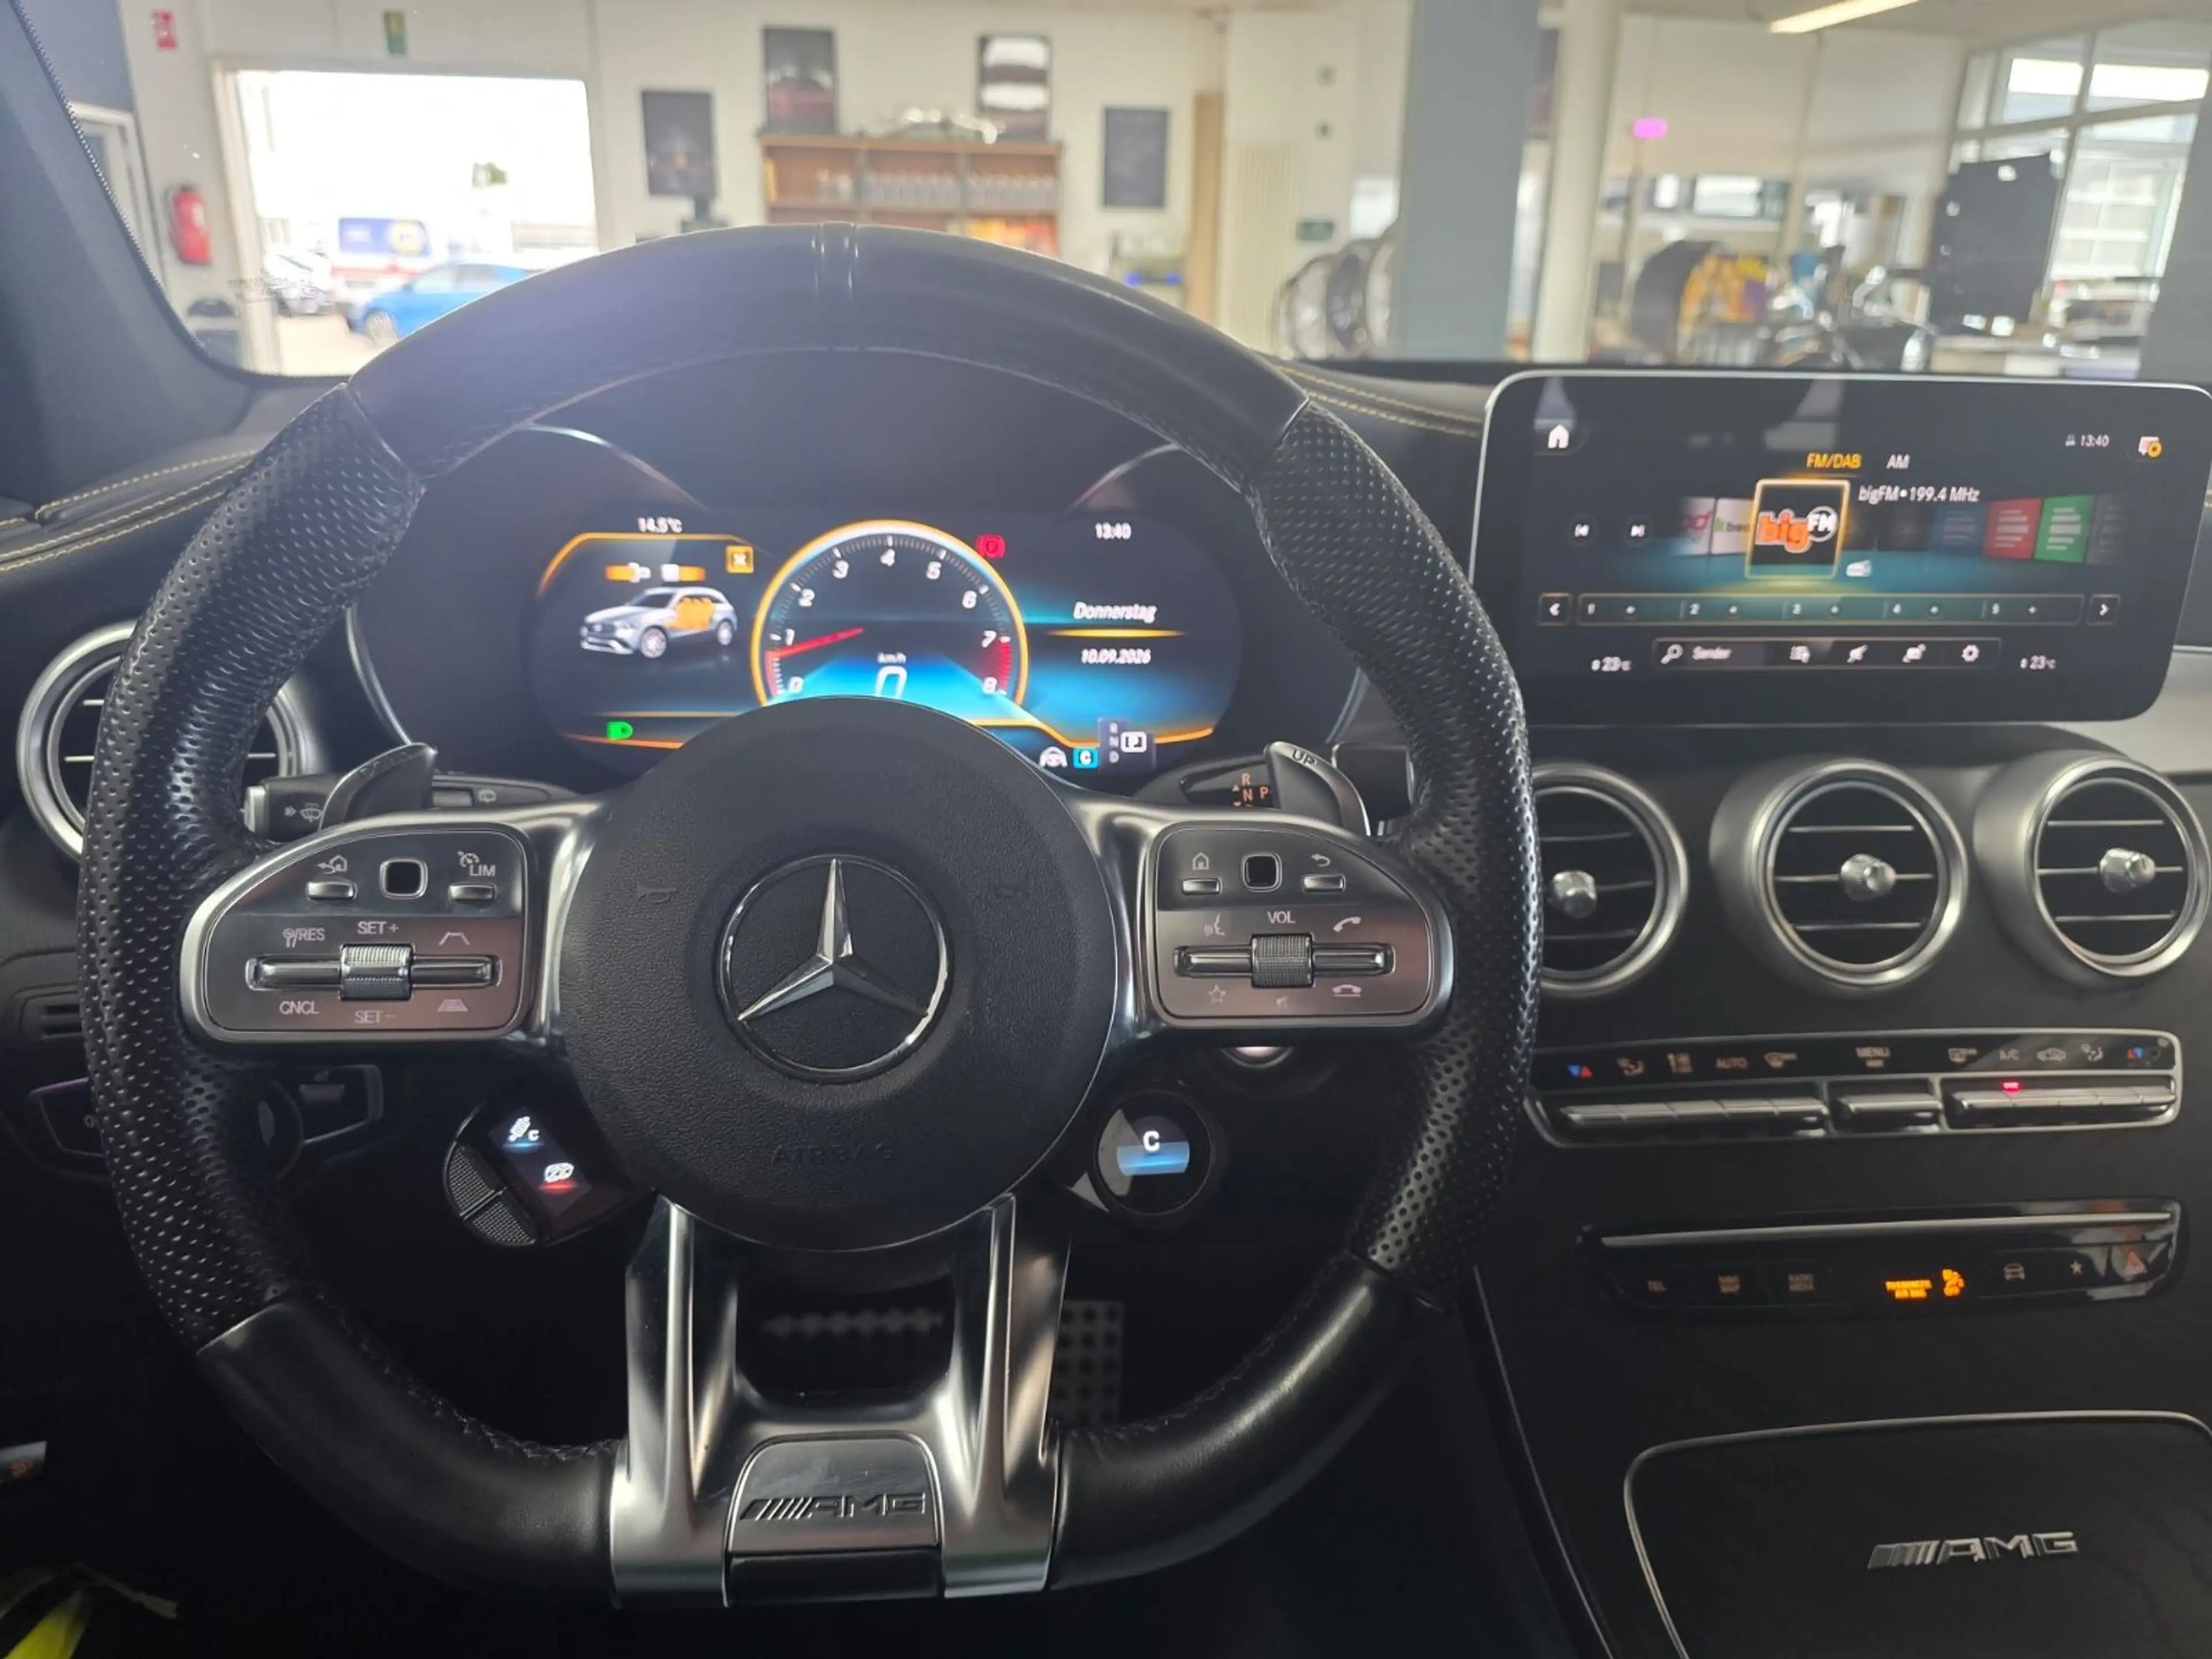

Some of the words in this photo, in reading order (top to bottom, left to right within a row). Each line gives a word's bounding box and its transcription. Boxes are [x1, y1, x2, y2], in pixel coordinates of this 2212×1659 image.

[2081, 434, 2109, 448] 13:40
[1807, 453, 1862, 469] FM/DAB
[1887, 454, 1910, 469] AM
[1949, 487, 1981, 503] MHz
[1095, 522, 1132, 540] 13:40
[1755, 509, 1812, 553] big
[880, 548, 896, 567] 4
[832, 560, 850, 579] 3
[926, 561, 942, 580] 5
[798, 588, 816, 607] 2
[962, 590, 978, 609] 6
[1073, 601, 1158, 624] Donnerstag
[1690, 602, 1700, 615] 2
[785, 628, 796, 646] 1
[981, 630, 997, 648] 7
[787, 676, 805, 694] 0
[876, 665, 908, 699] 0
[982, 676, 998, 694] 8
[1292, 749, 1316, 766] UP
[1241, 772, 1251, 787] R
[1243, 788, 1253, 802] N
[1260, 786, 1269, 800] P
[469, 864, 496, 877] LIM
[1267, 910, 1296, 925] VOL
[279, 1001, 320, 1015] CNCL
[1715, 1056, 1748, 1069] AUTO
[1143, 1130, 1161, 1152] C
